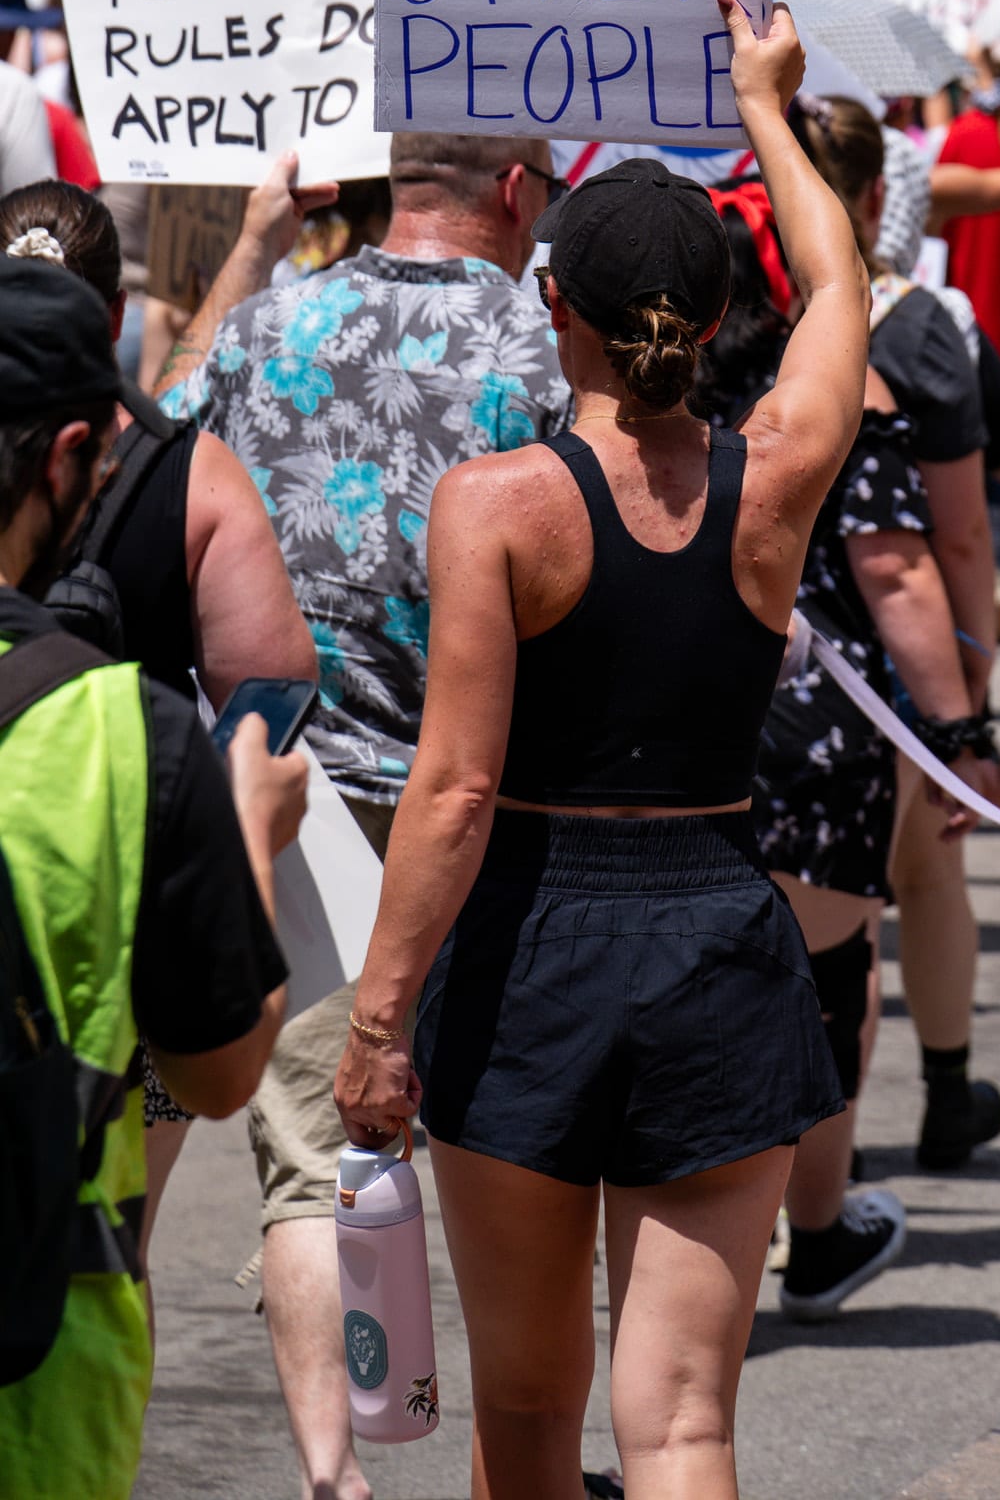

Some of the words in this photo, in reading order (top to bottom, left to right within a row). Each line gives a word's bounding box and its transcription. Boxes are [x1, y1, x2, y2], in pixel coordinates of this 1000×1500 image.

[105, 14, 284, 77] RULES
[401, 14, 744, 129] PEOPLE
[111, 92, 276, 152] APPLY
[291, 78, 359, 138] TO
